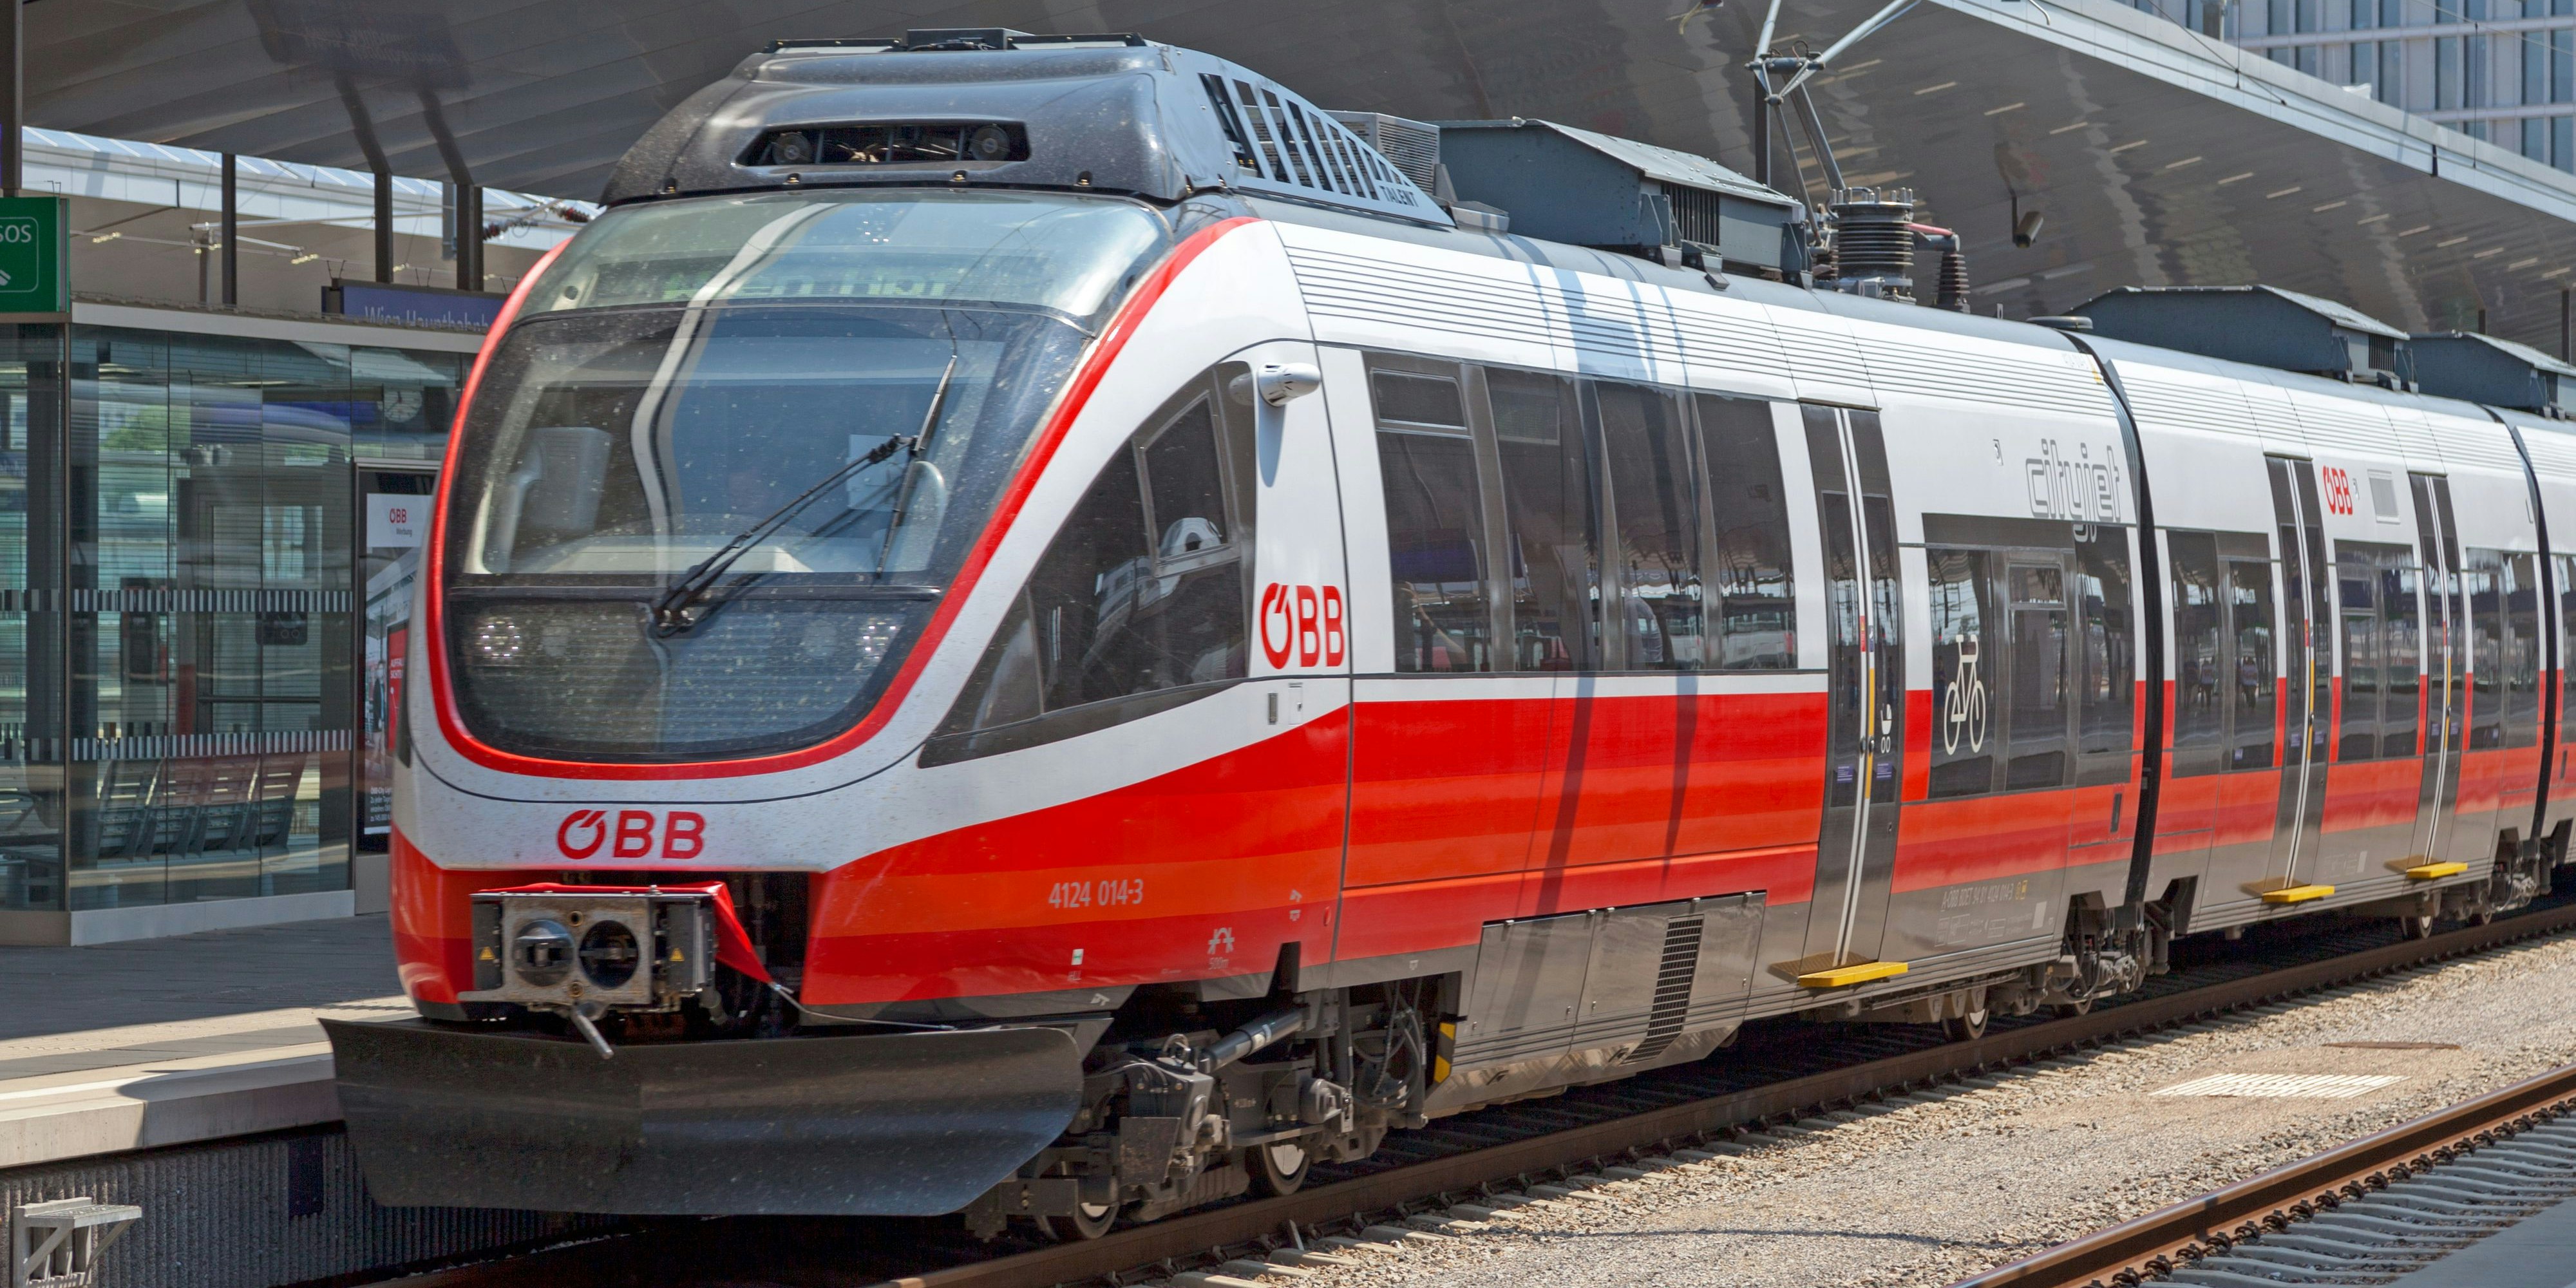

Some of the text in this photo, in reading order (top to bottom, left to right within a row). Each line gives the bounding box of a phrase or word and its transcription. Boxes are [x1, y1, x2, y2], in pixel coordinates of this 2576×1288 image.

[1379, 185, 1419, 207] TALENT
[365, 305, 401, 325] Wien
[2025, 438, 2120, 543] cityjet
[2323, 466, 2353, 515] ÖBB
[389, 507, 407, 524] ÖBB
[1260, 582, 1345, 670] ÖBB
[558, 810, 706, 860] ÖBB
[1048, 878, 1144, 909] 4124 014-3
